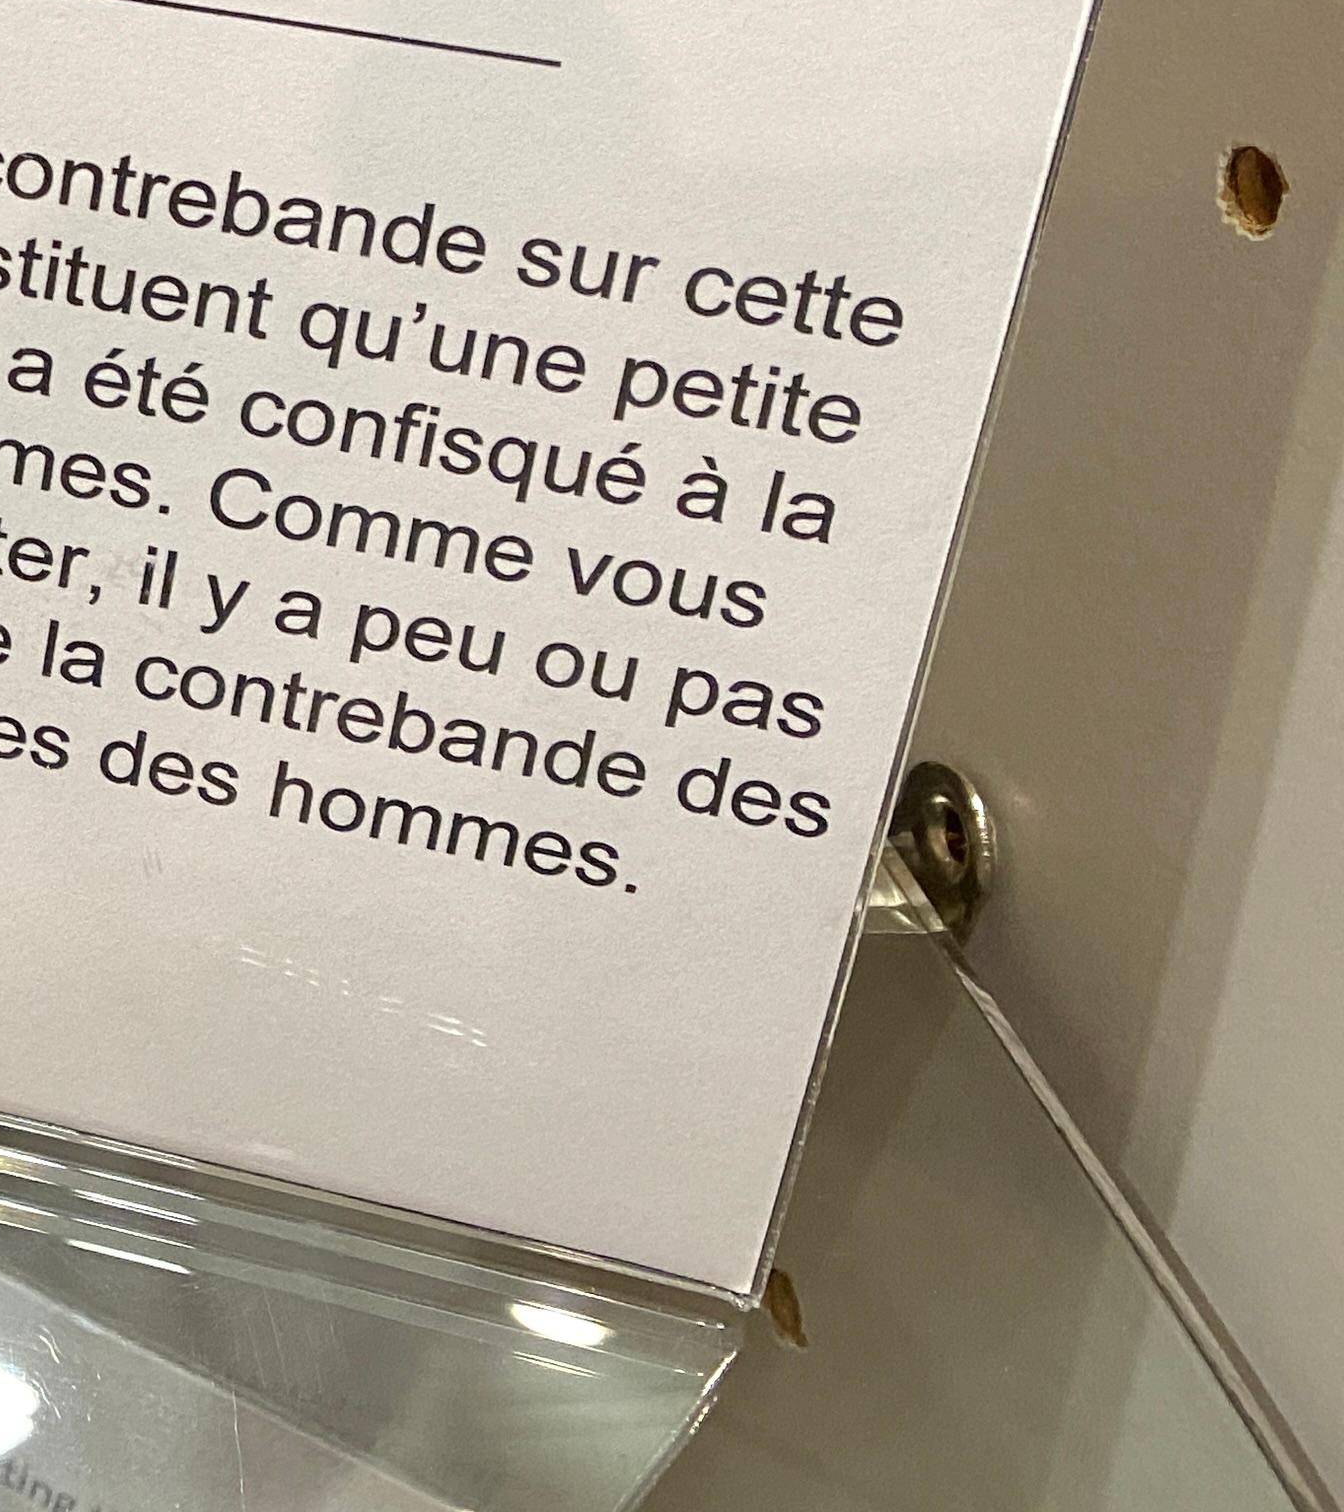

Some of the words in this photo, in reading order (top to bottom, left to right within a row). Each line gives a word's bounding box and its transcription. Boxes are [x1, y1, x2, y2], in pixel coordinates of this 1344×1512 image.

[299, 301, 587, 394] qu’une
[612, 356, 862, 445] petite
[516, 237, 661, 304] sur
[684, 266, 904, 348] cette
[6, 346, 54, 398] a
[83, 346, 210, 425] été
[239, 390, 647, 506] confisqué
[675, 454, 729, 525] à
[760, 468, 836, 546] la
[209, 466, 534, 583] Comme
[566, 546, 768, 629] vous
[137, 544, 179, 610] il
[199, 573, 252, 635] y
[273, 589, 323, 640] a
[348, 603, 507, 677] peu
[534, 641, 640, 703] ou
[663, 666, 825, 740] pas
[40, 618, 106, 689] la
[134, 655, 647, 799] contrebande
[676, 756, 832, 839] des
[98, 728, 240, 807] des
[268, 759, 638, 895] hommes.
